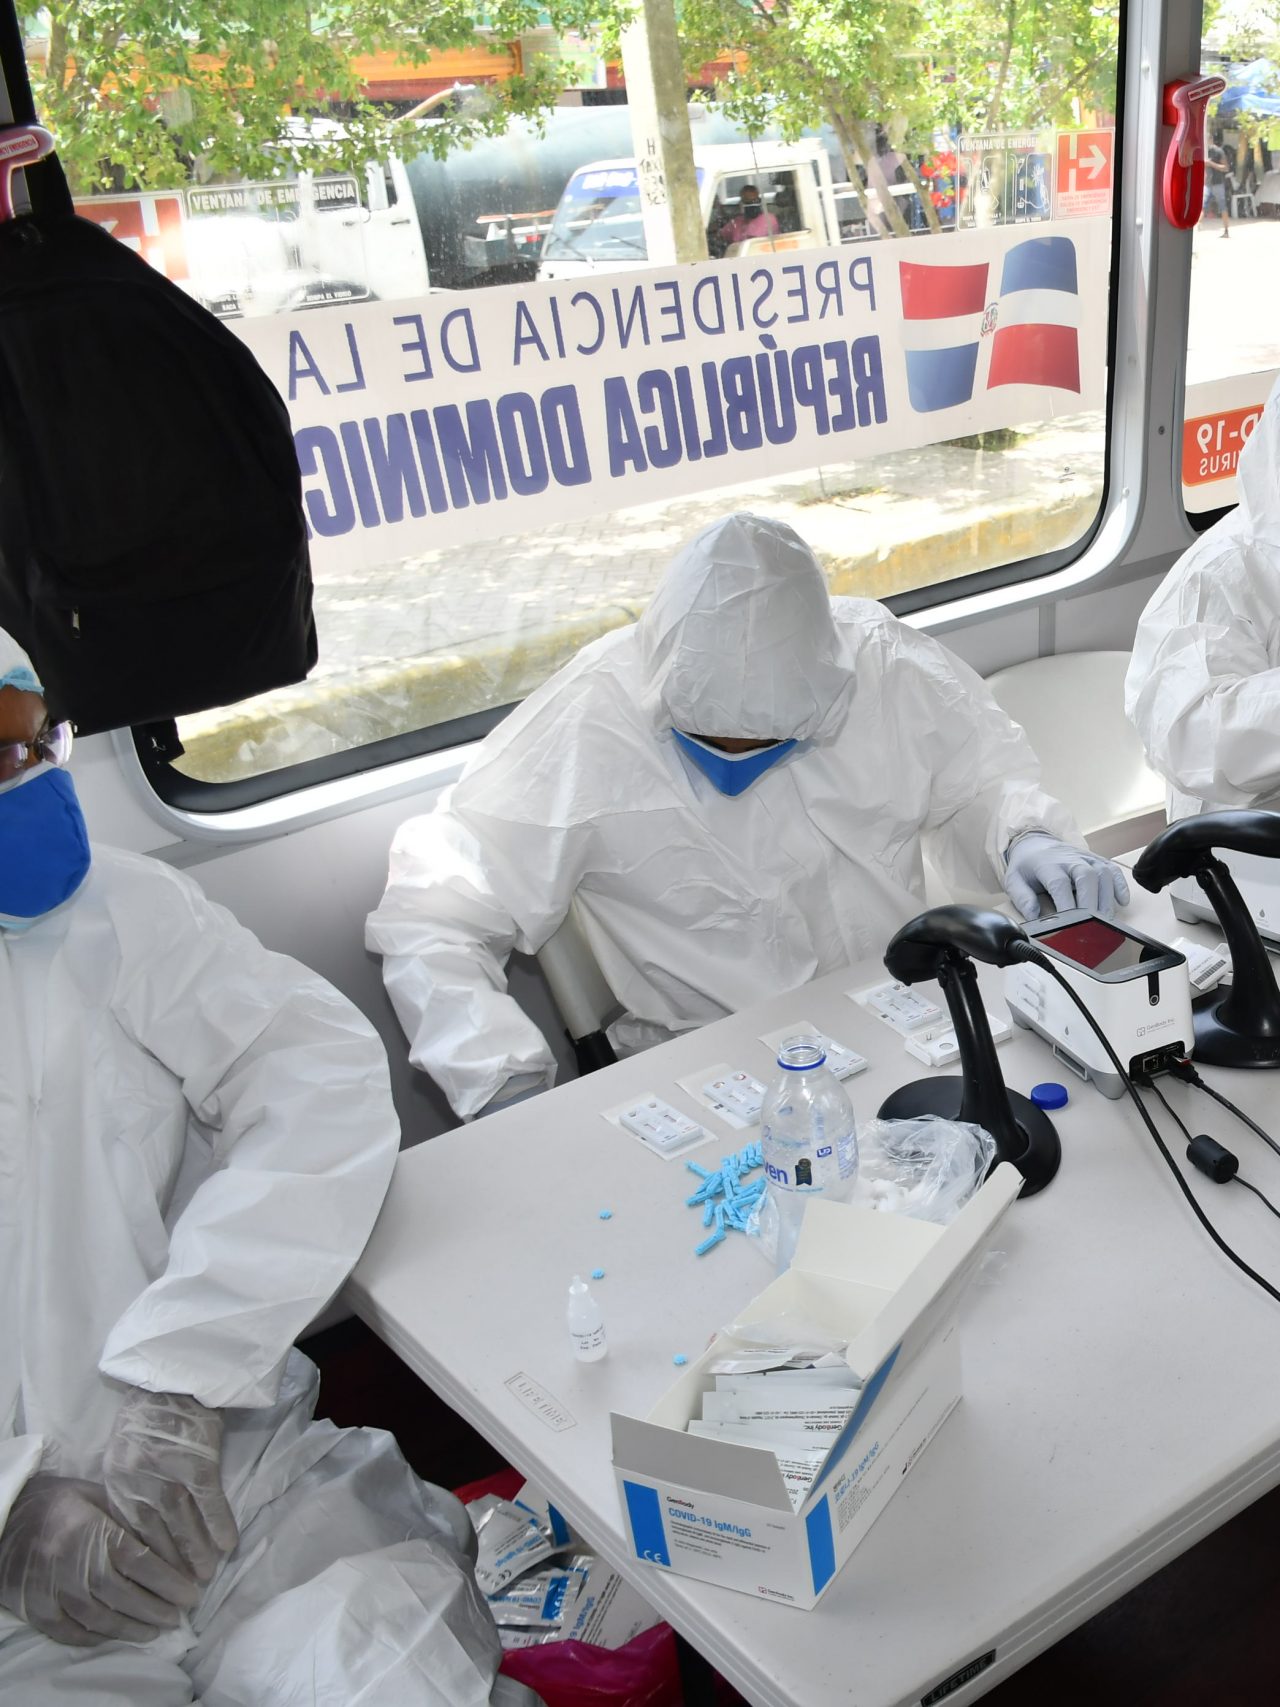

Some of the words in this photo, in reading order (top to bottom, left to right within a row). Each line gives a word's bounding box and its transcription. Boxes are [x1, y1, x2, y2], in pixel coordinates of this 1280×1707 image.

[192, 192, 249, 211] VENTANA
[257, 189, 273, 204] DE
[668, 1507, 713, 1528] COVID-19
[714, 1519, 752, 1539] IgM/IgG
